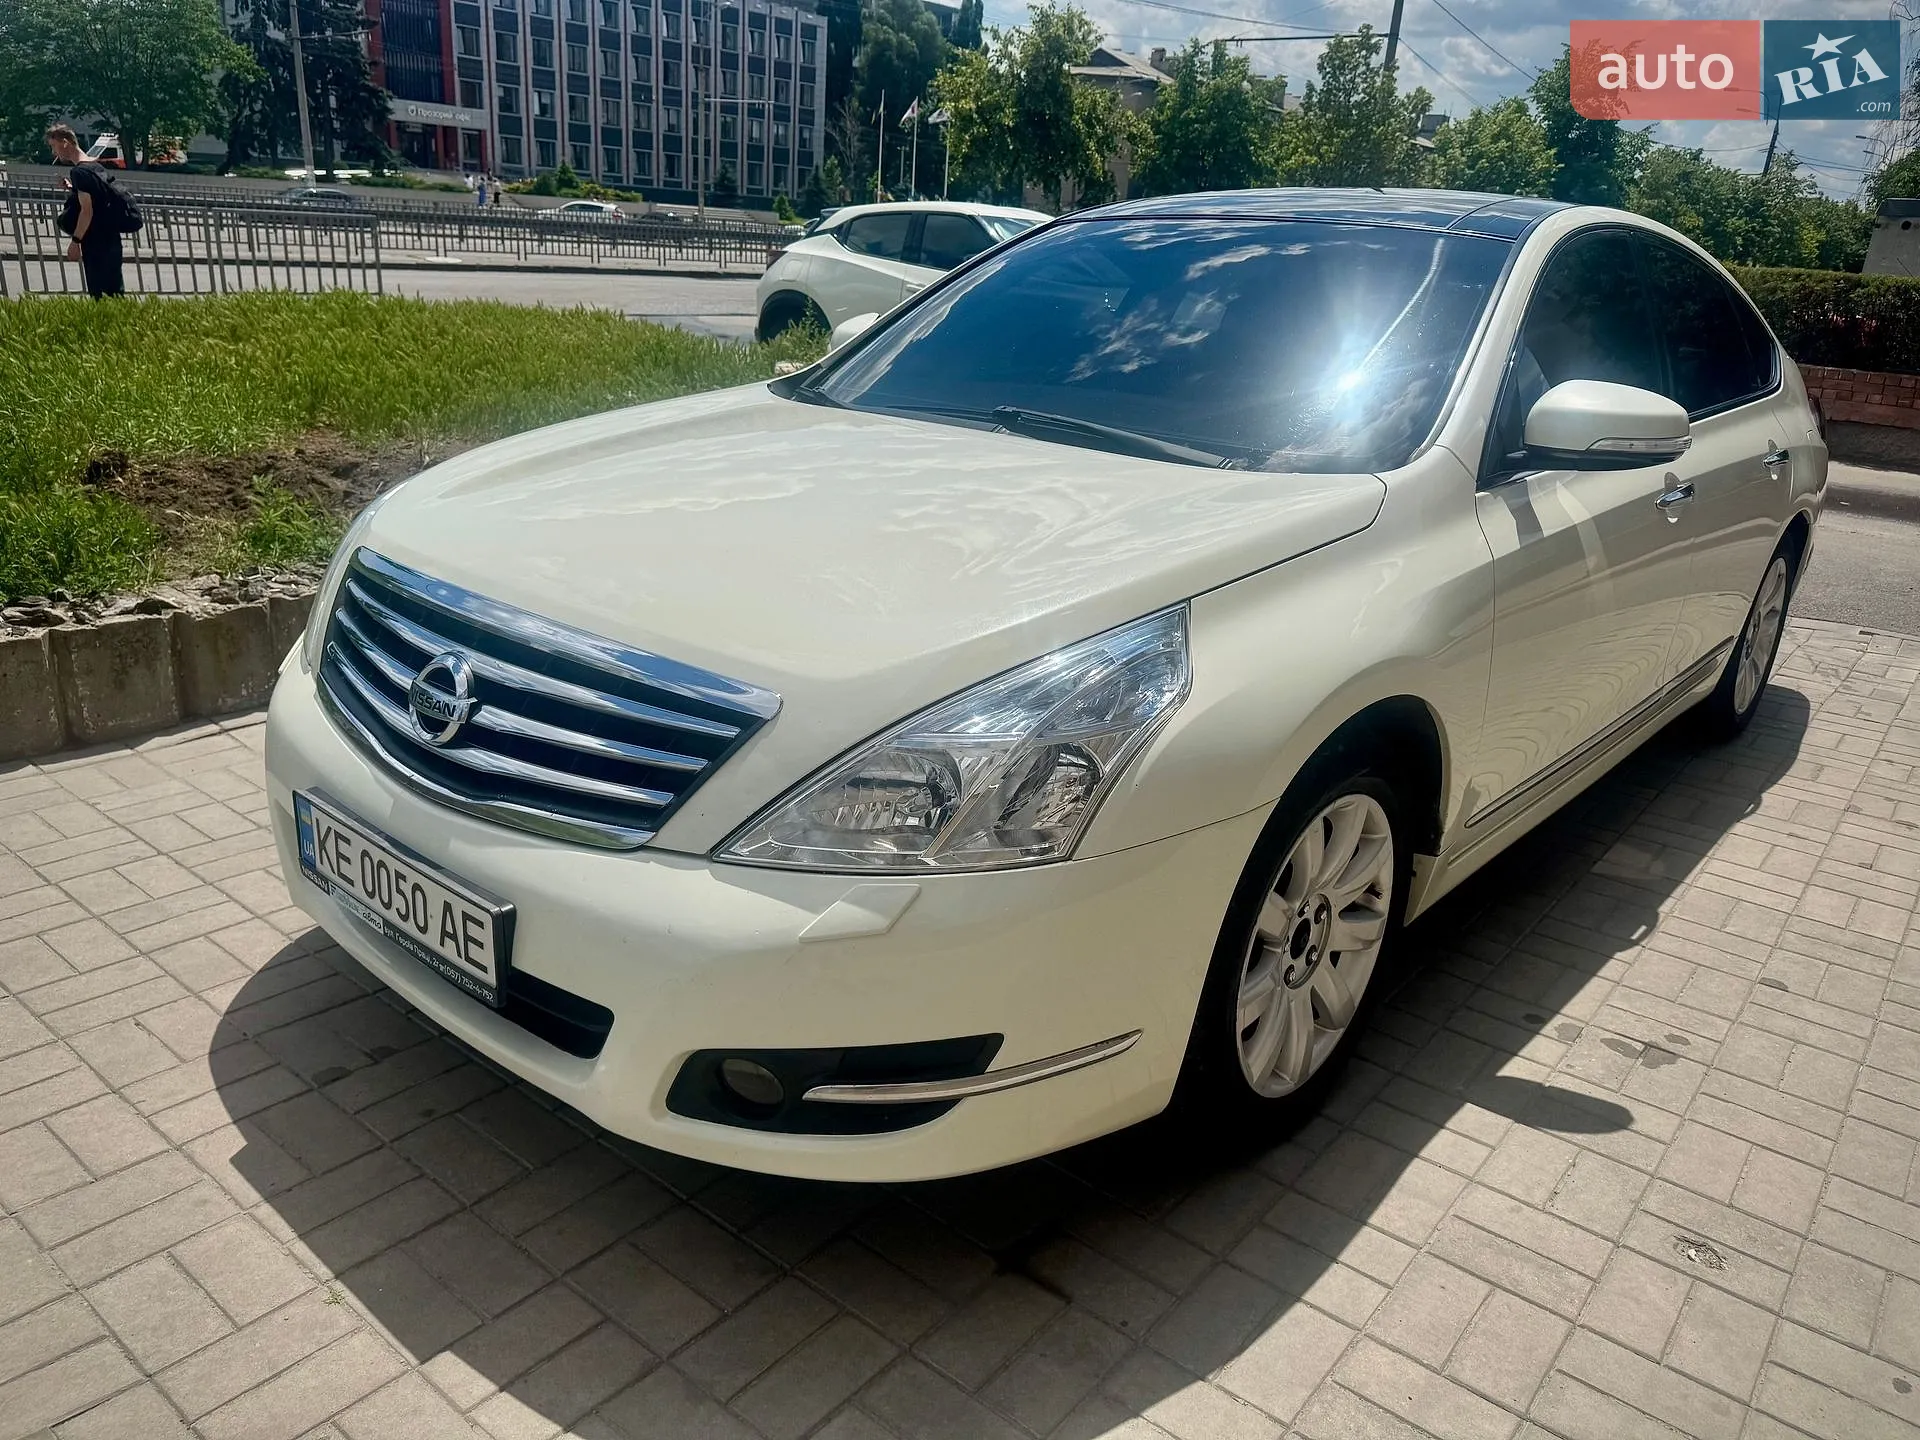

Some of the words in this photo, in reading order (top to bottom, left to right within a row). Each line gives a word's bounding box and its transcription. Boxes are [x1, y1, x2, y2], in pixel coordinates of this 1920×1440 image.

[411, 684, 456, 719] NISSAN
[303, 839, 315, 858] UA
[315, 817, 355, 888] KE
[360, 849, 428, 935] 0050
[439, 899, 488, 975] AE
